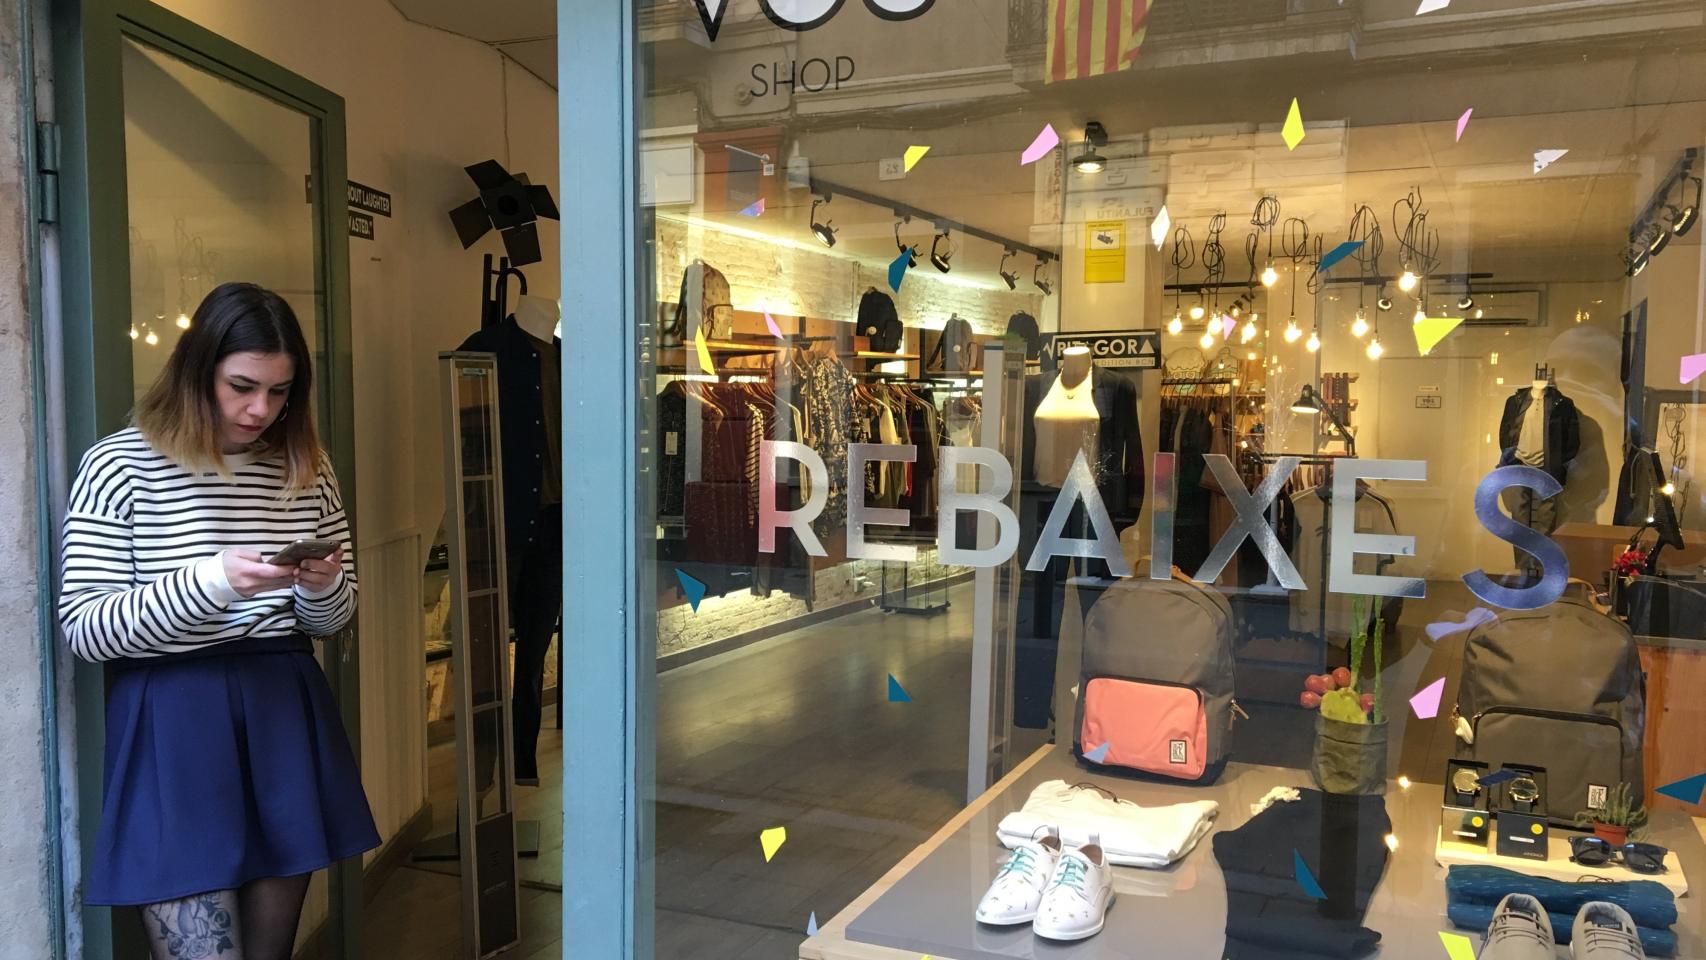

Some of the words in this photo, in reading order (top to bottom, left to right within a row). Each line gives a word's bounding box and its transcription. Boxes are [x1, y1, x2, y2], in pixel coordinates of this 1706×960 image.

[750, 56, 855, 97] SHOP
[362, 190, 390, 213] LAUGHTER
[1057, 339, 1155, 356] PGORA
[758, 439, 1570, 610] REBAIXES
